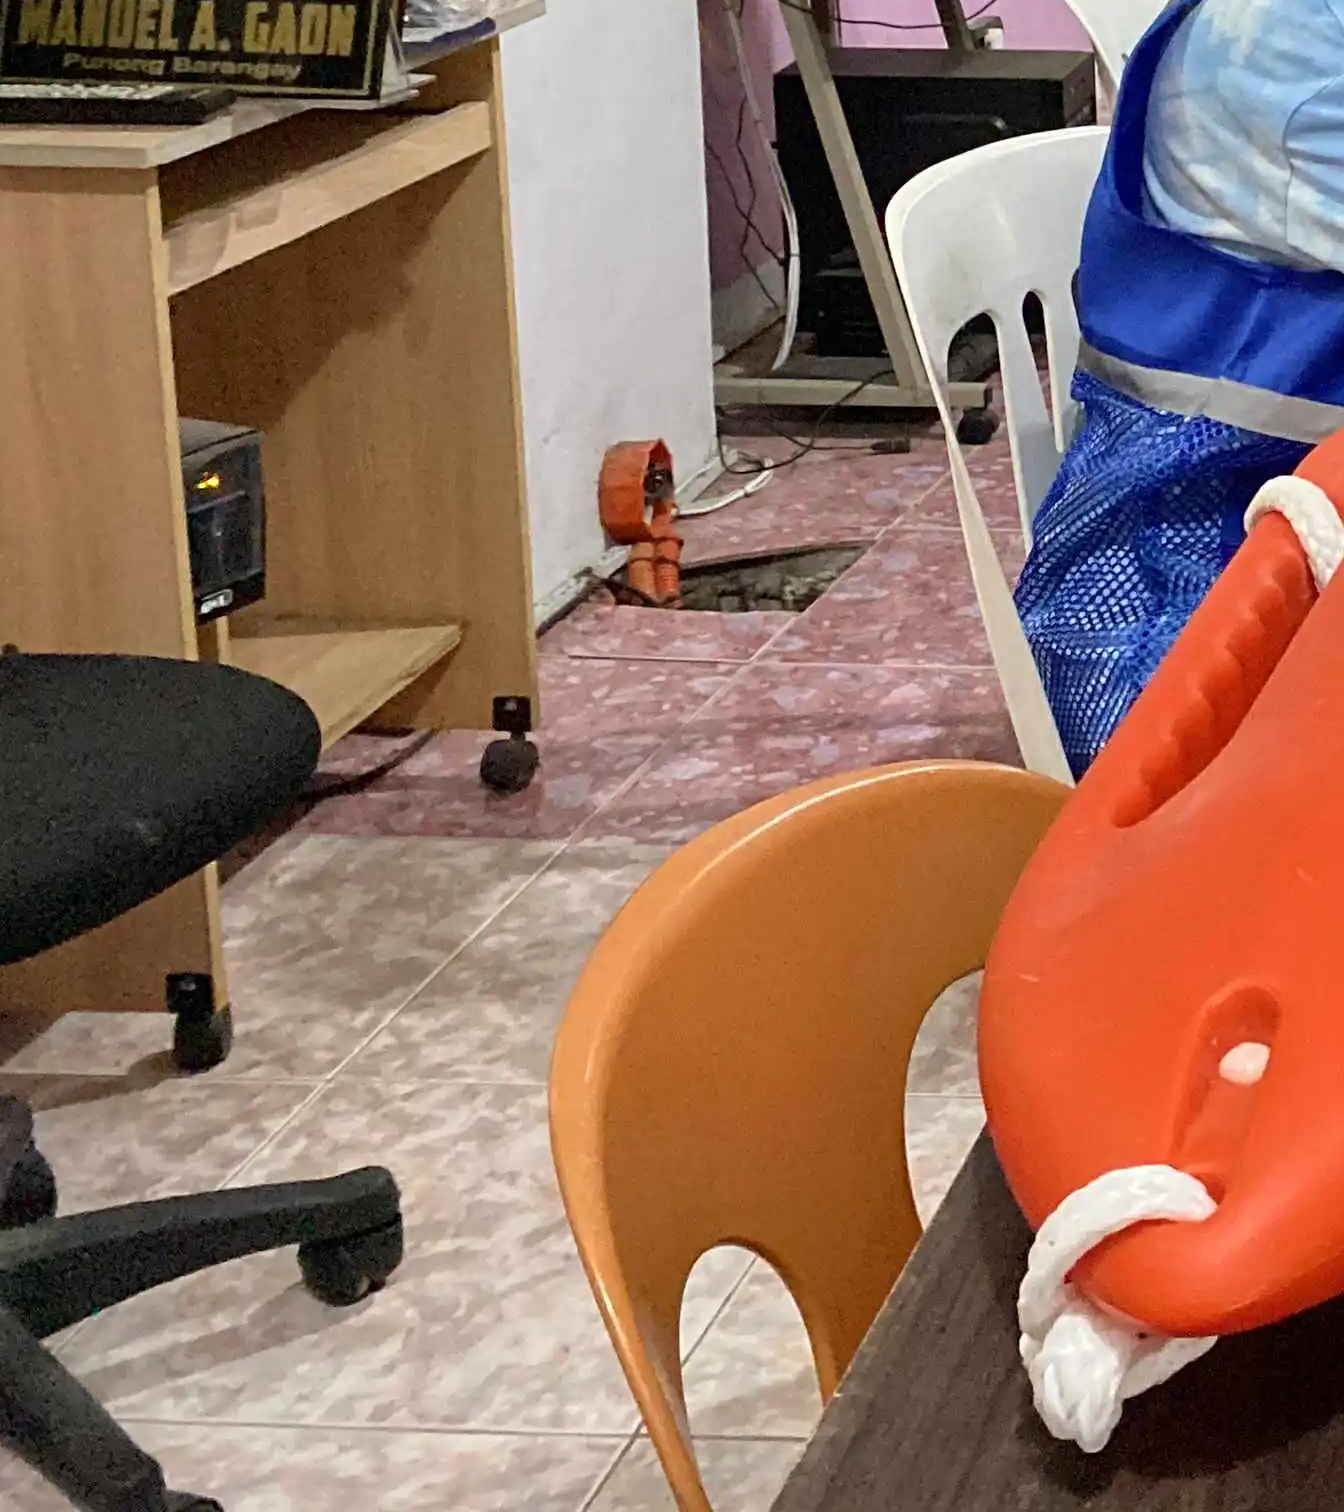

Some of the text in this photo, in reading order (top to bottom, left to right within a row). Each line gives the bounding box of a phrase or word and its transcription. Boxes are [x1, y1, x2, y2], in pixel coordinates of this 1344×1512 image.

[188, 0, 231, 52] A.
[62, 51, 300, 81] Punong Barangay
